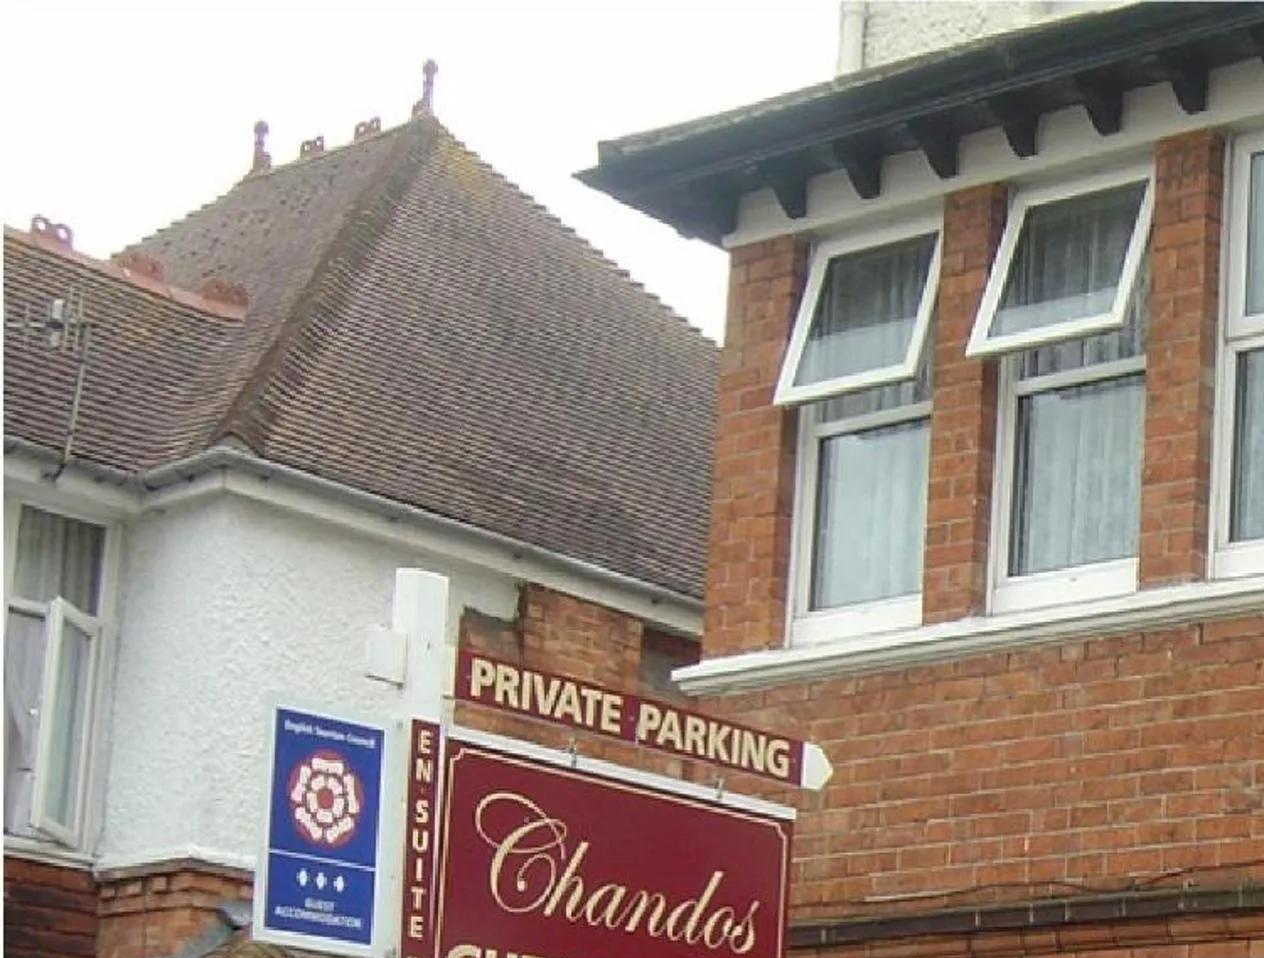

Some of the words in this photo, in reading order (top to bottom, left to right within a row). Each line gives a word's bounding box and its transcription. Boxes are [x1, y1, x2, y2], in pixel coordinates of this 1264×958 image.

[416, 729, 432, 783] EN
[470, 657, 622, 733] PRIVATE
[637, 702, 791, 778] PARKING
[410, 799, 430, 939] SUITE
[475, 792, 760, 954] Chandos
